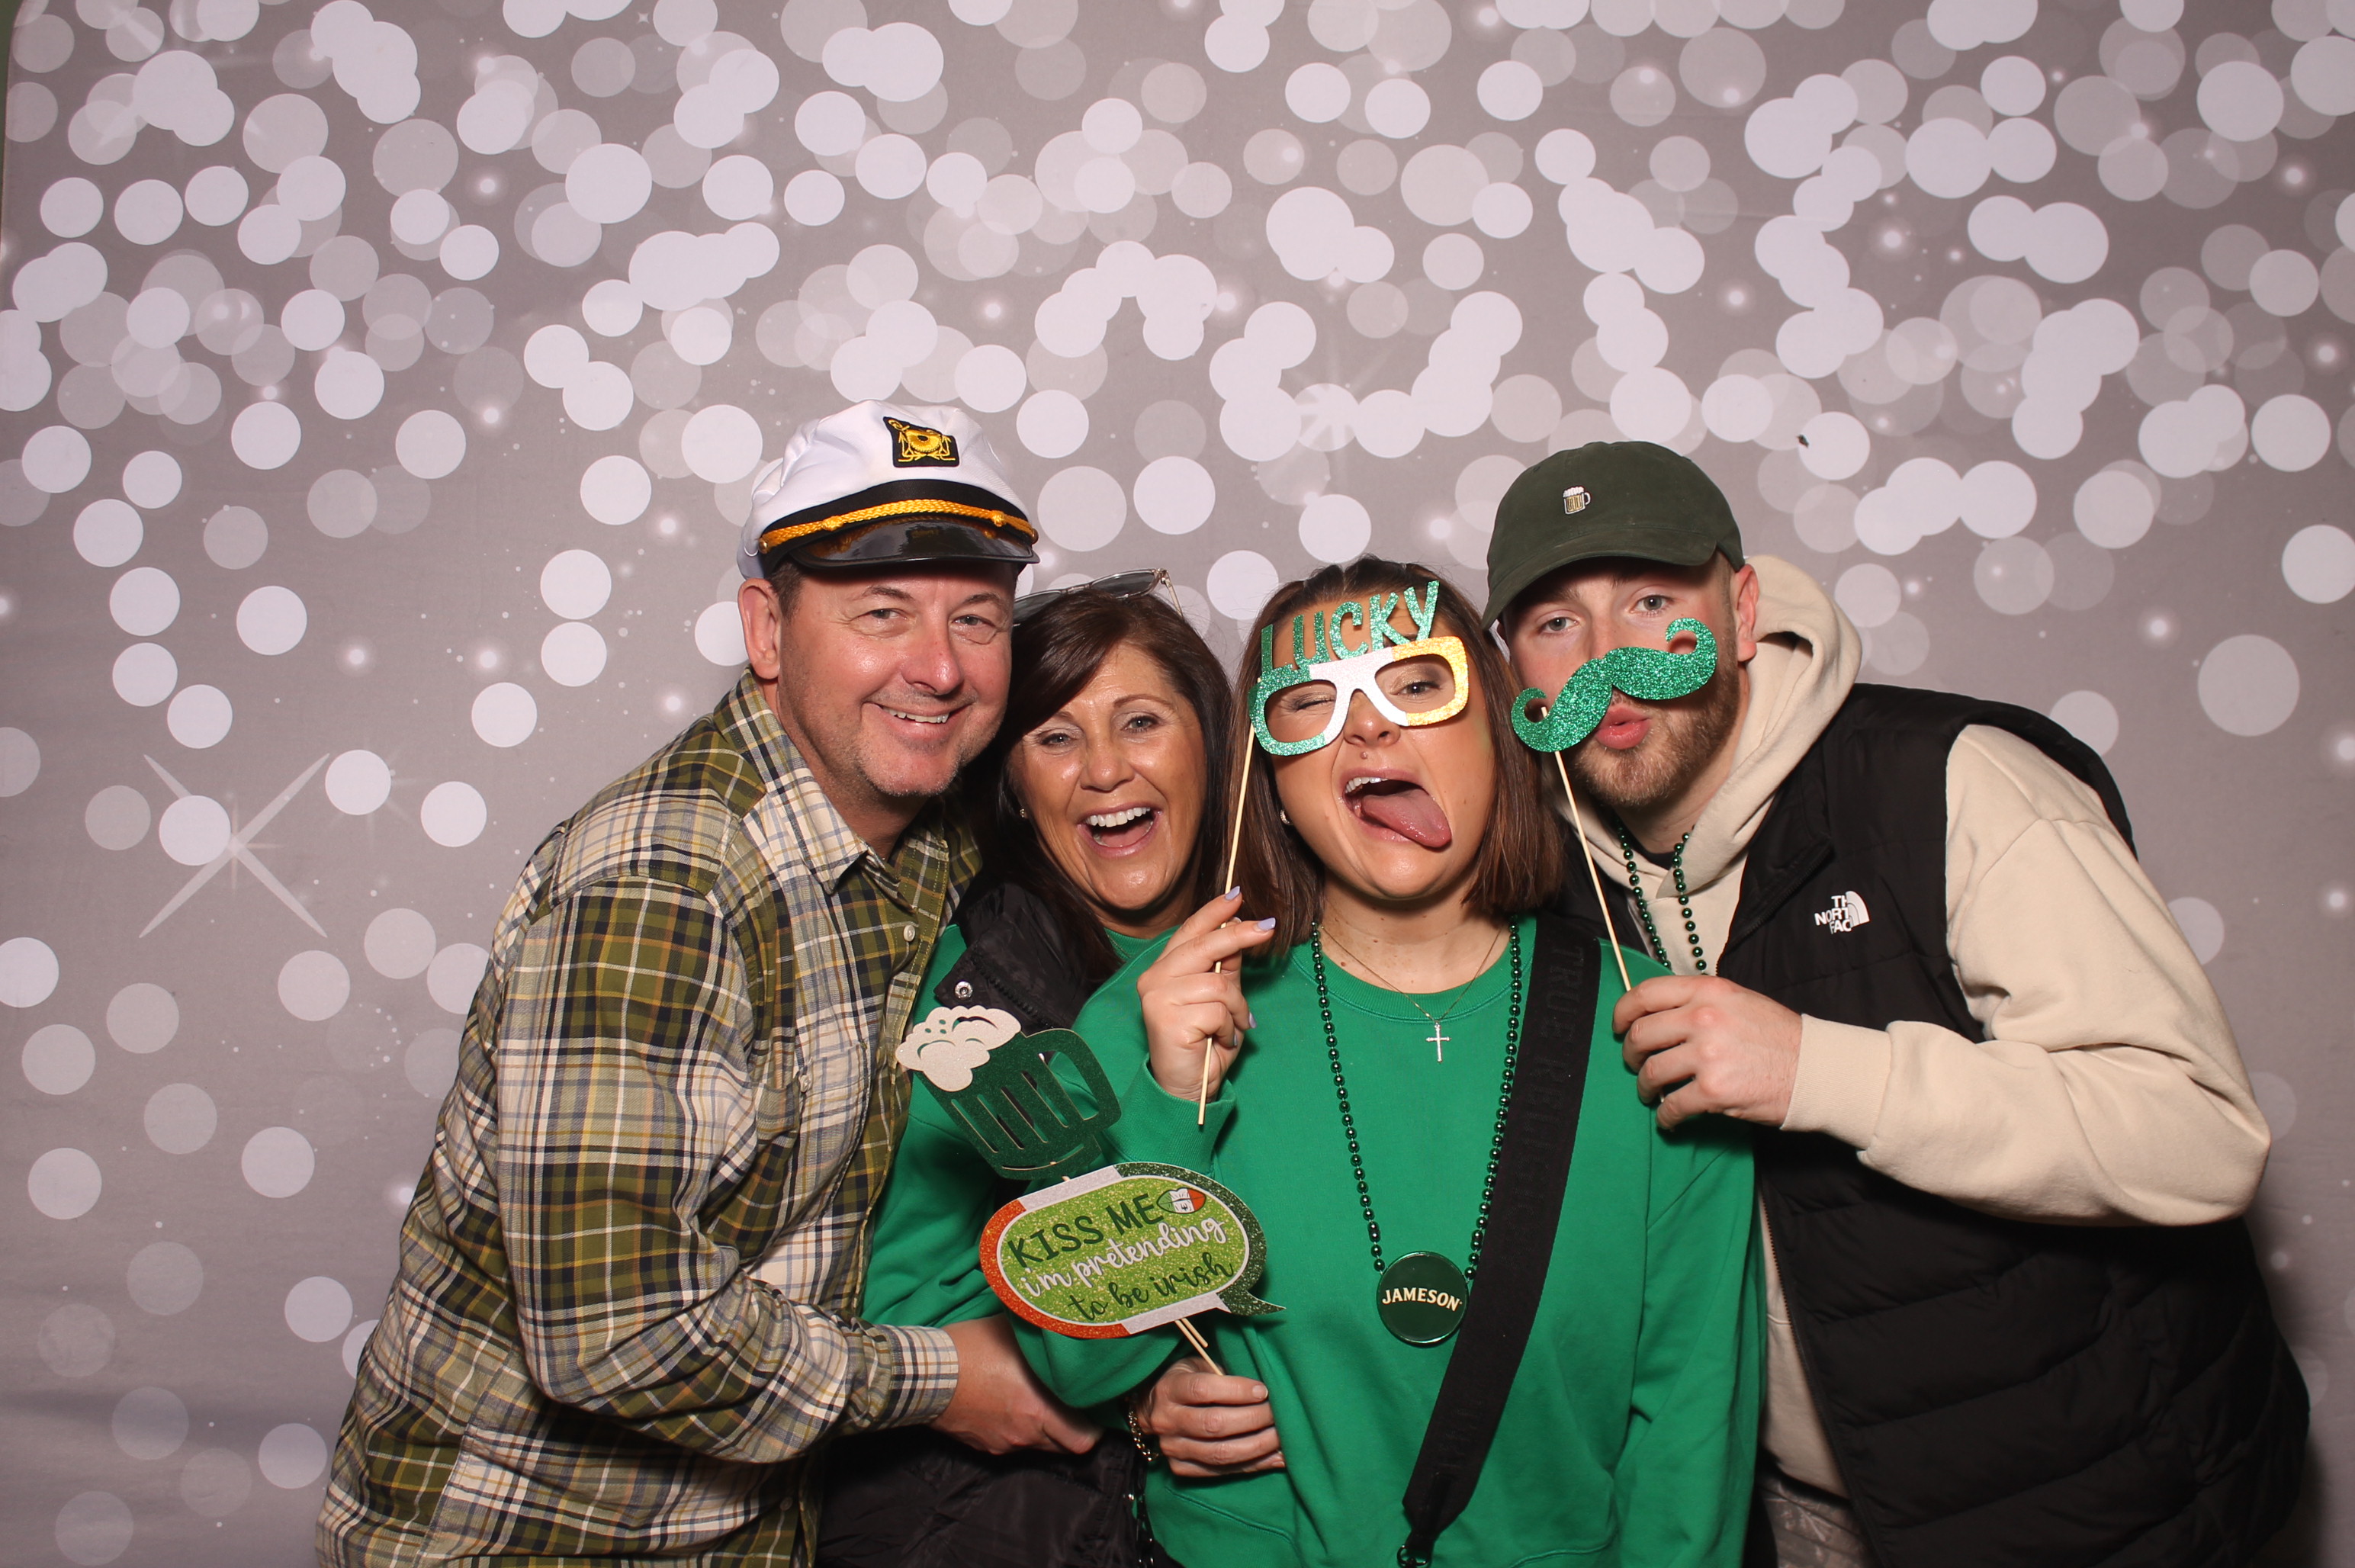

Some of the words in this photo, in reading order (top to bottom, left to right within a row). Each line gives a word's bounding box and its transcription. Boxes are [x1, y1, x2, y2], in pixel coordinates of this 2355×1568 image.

[1261, 580, 1440, 671] LUCKY
[1814, 907, 1849, 926] NORT
[1830, 919, 1852, 934] FAC
[1539, 945, 1585, 1043] TRUE
[1007, 1216, 1104, 1268] KISS
[1106, 1193, 1165, 1236] ME
[1071, 1215, 1228, 1289] pretending
[1068, 1293, 1109, 1321] to
[1108, 1282, 1149, 1309] be
[1149, 1252, 1235, 1296] irish
[1382, 1287, 1460, 1312] JAMESON
